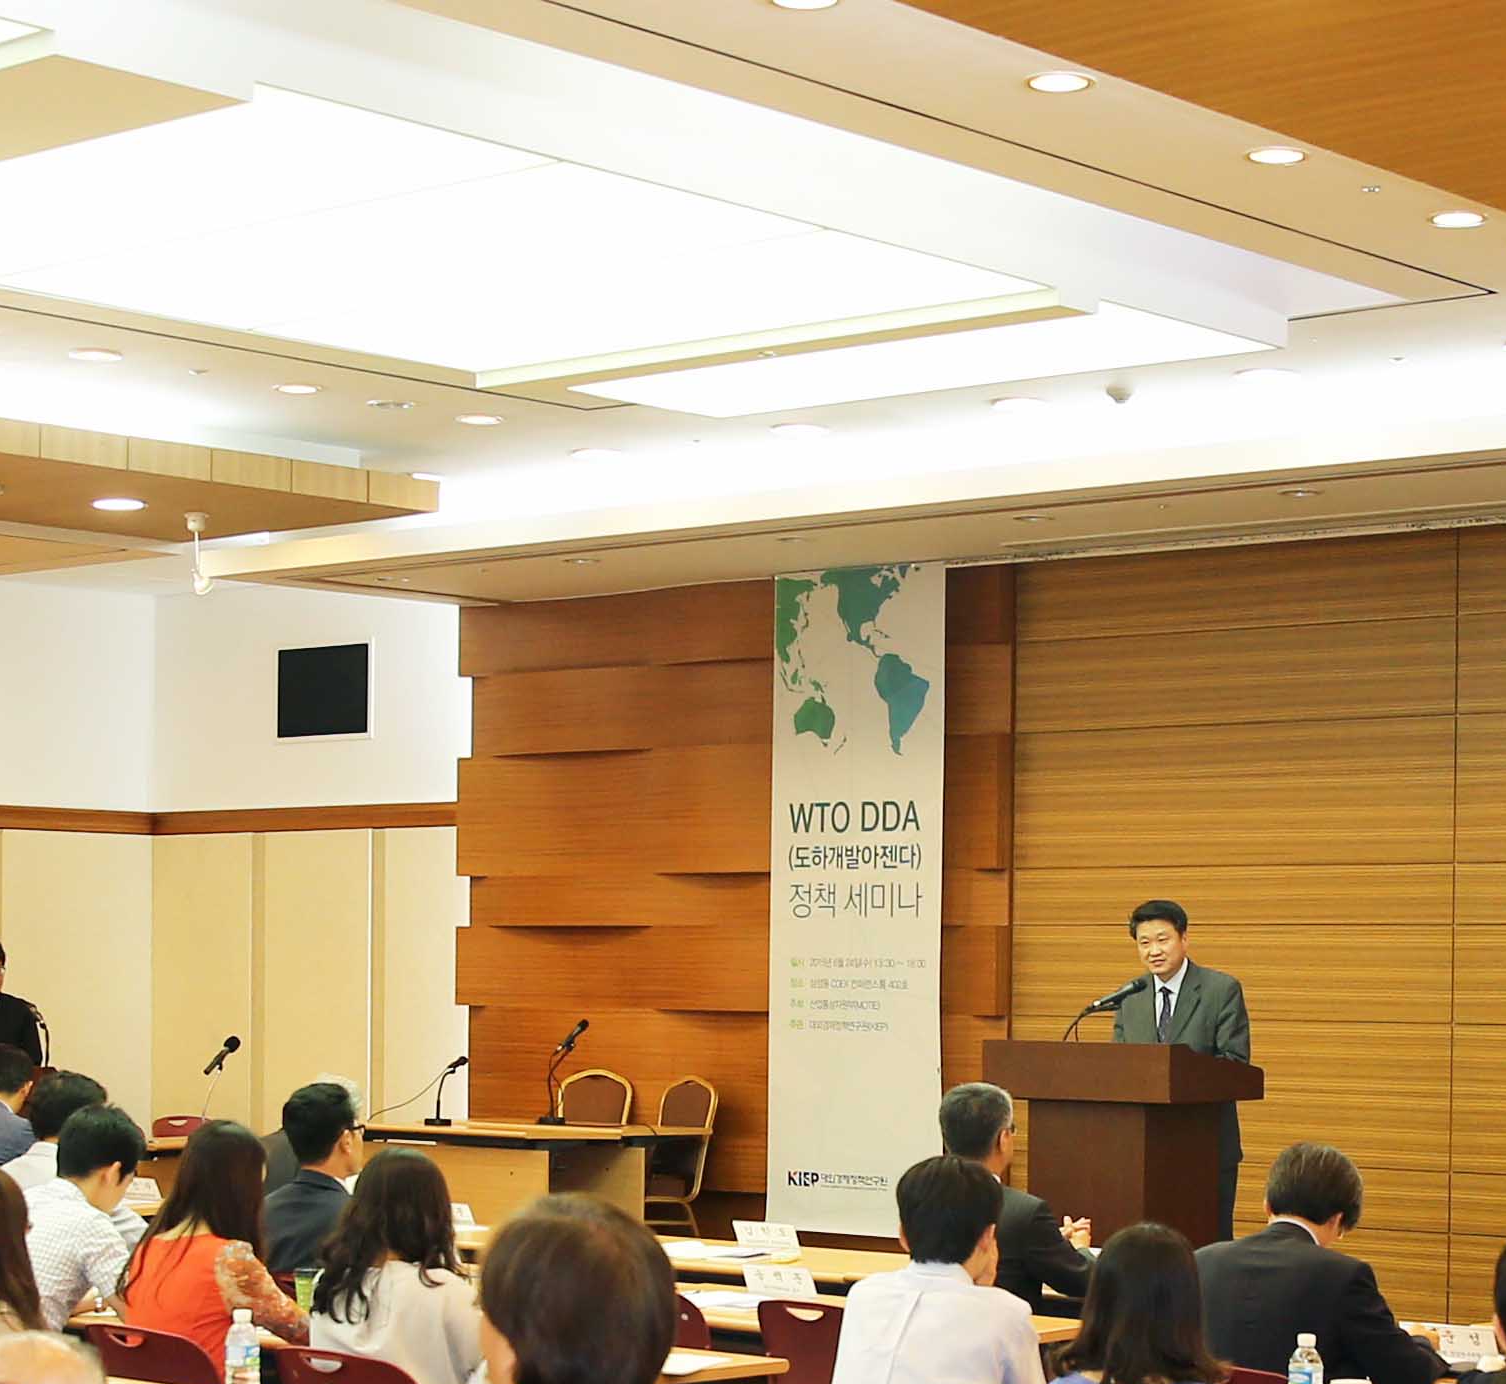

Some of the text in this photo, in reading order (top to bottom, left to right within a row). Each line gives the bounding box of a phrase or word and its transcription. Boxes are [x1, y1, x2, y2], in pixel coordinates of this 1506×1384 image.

[789, 799, 921, 833] WTO DDA
[788, 842, 922, 872] (도하개발아젠다)
[788, 881, 923, 919] 정책 세미나
[787, 1170, 820, 1188] KIEP
